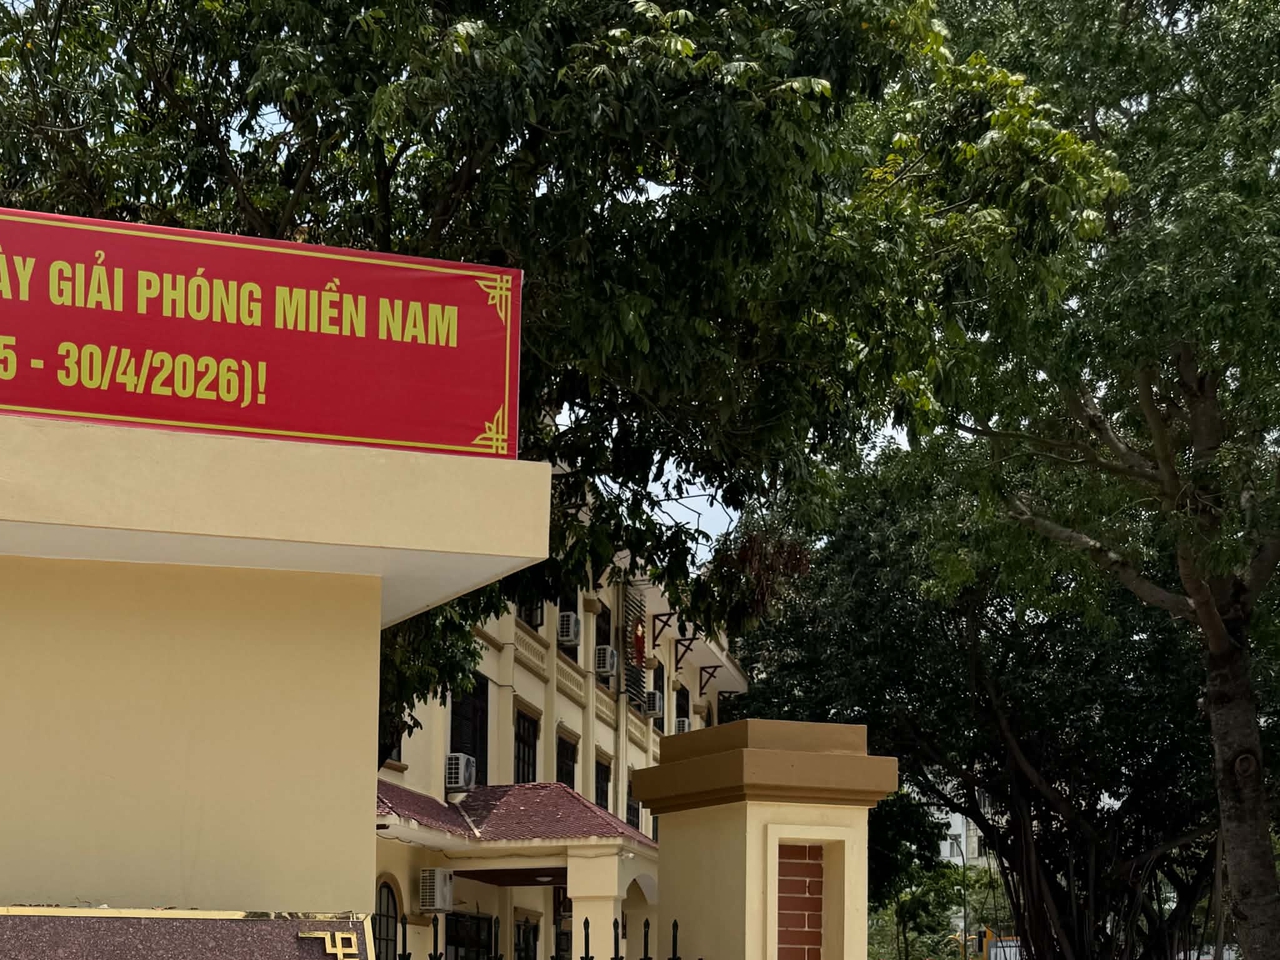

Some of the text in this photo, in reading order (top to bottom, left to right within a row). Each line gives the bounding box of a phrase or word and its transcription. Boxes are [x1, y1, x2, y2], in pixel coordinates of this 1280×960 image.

[48, 249, 124, 312] GIẢI
[137, 267, 262, 327] PHÓNG
[275, 277, 367, 338] MIỀN
[378, 298, 459, 348] NAM
[30, 358, 44, 369] -
[56, 341, 266, 408] 30/4/2026)!
